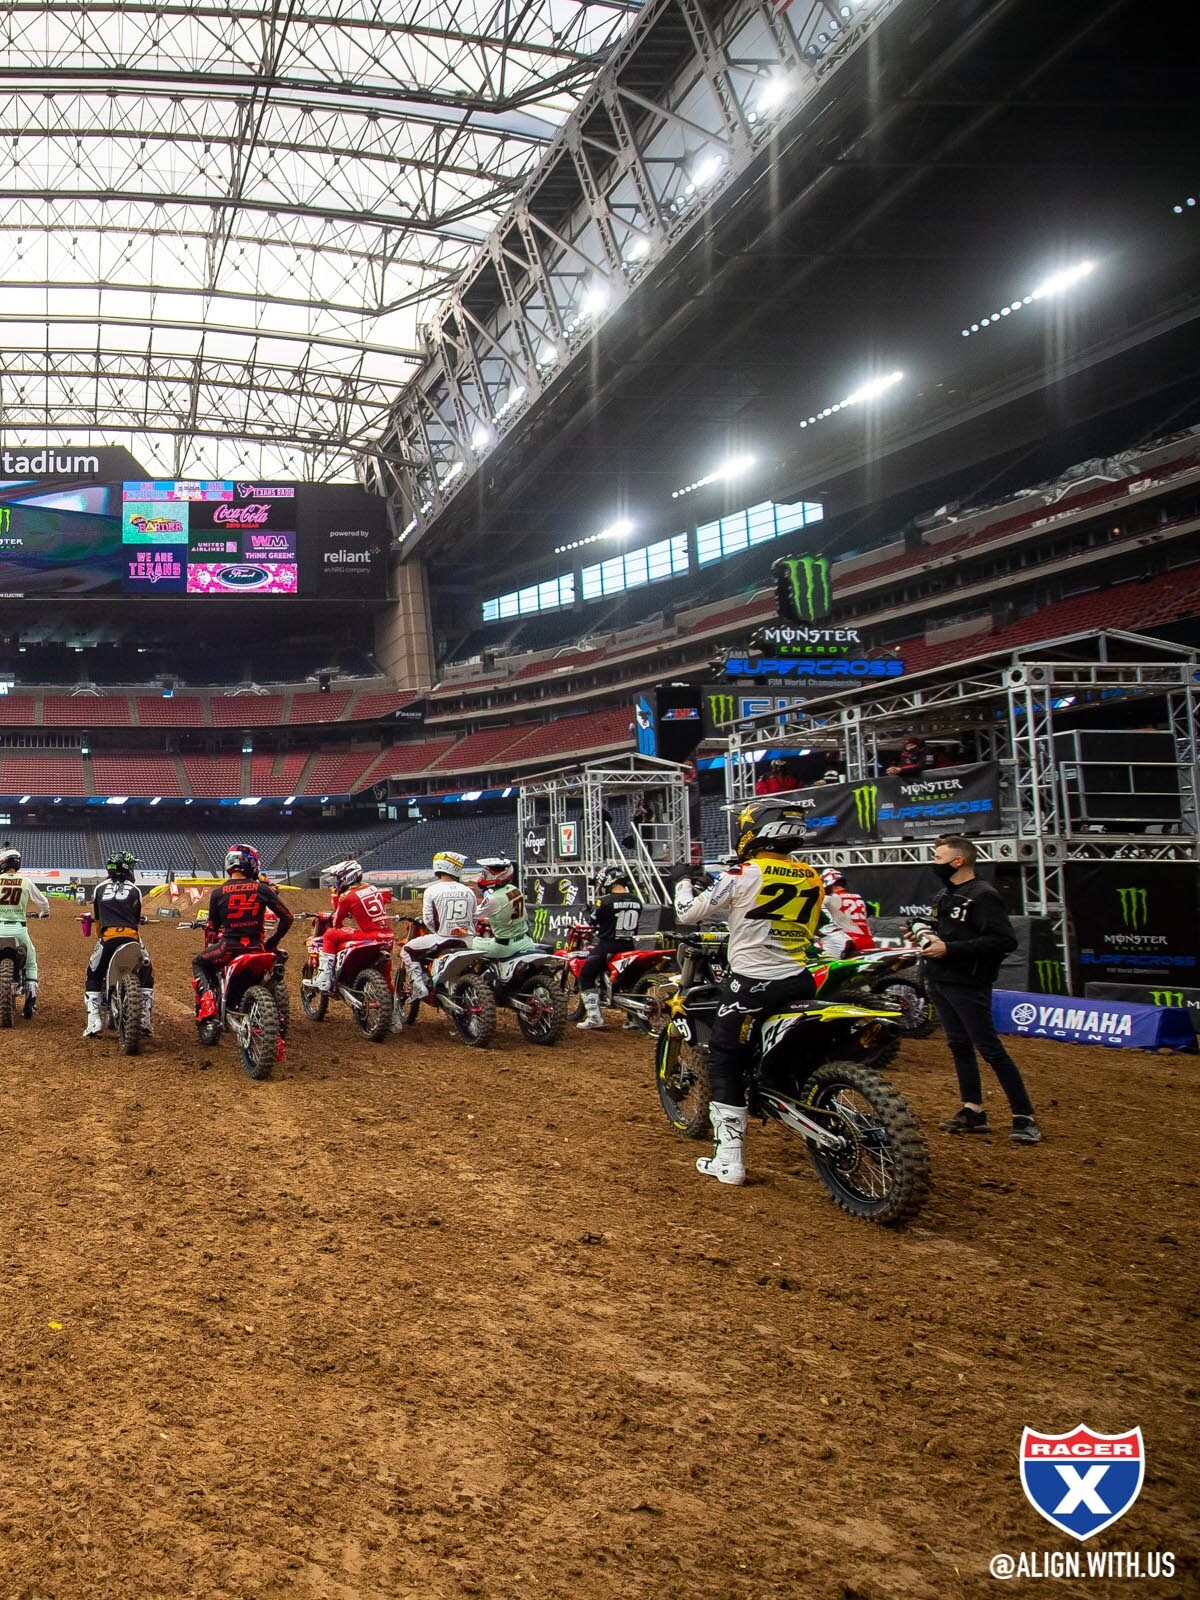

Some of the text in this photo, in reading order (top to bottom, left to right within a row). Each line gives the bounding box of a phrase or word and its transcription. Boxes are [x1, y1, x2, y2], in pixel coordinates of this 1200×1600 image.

[329, 530, 369, 538] powered by
[136, 553, 173, 562] WE ARE
[324, 549, 371, 562] reliant
[129, 562, 181, 576] TEXANS
[764, 627, 861, 644] MONSTER
[728, 651, 748, 659] AMA
[725, 659, 905, 676] SUPERCROSS
[808, 679, 862, 687] Championship
[901, 778, 962, 796] MONSTER
[911, 793, 955, 802] ENERGY
[878, 798, 993, 821] SUPERCROSS
[525, 831, 546, 855] Kroger
[0, 878, 22, 886] TICKLE
[222, 883, 259, 893] ROCZEN
[0, 887, 23, 905] 20
[744, 882, 820, 924] 21
[227, 894, 260, 919] 94
[446, 900, 467, 920] 19
[842, 899, 866, 919] 23
[951, 907, 967, 922] 31
[614, 910, 639, 931] 10
[1104, 933, 1168, 945] MONSTER
[1039, 1006, 1132, 1036] YAMAHA
[1017, 1026, 1123, 1043] RACING
